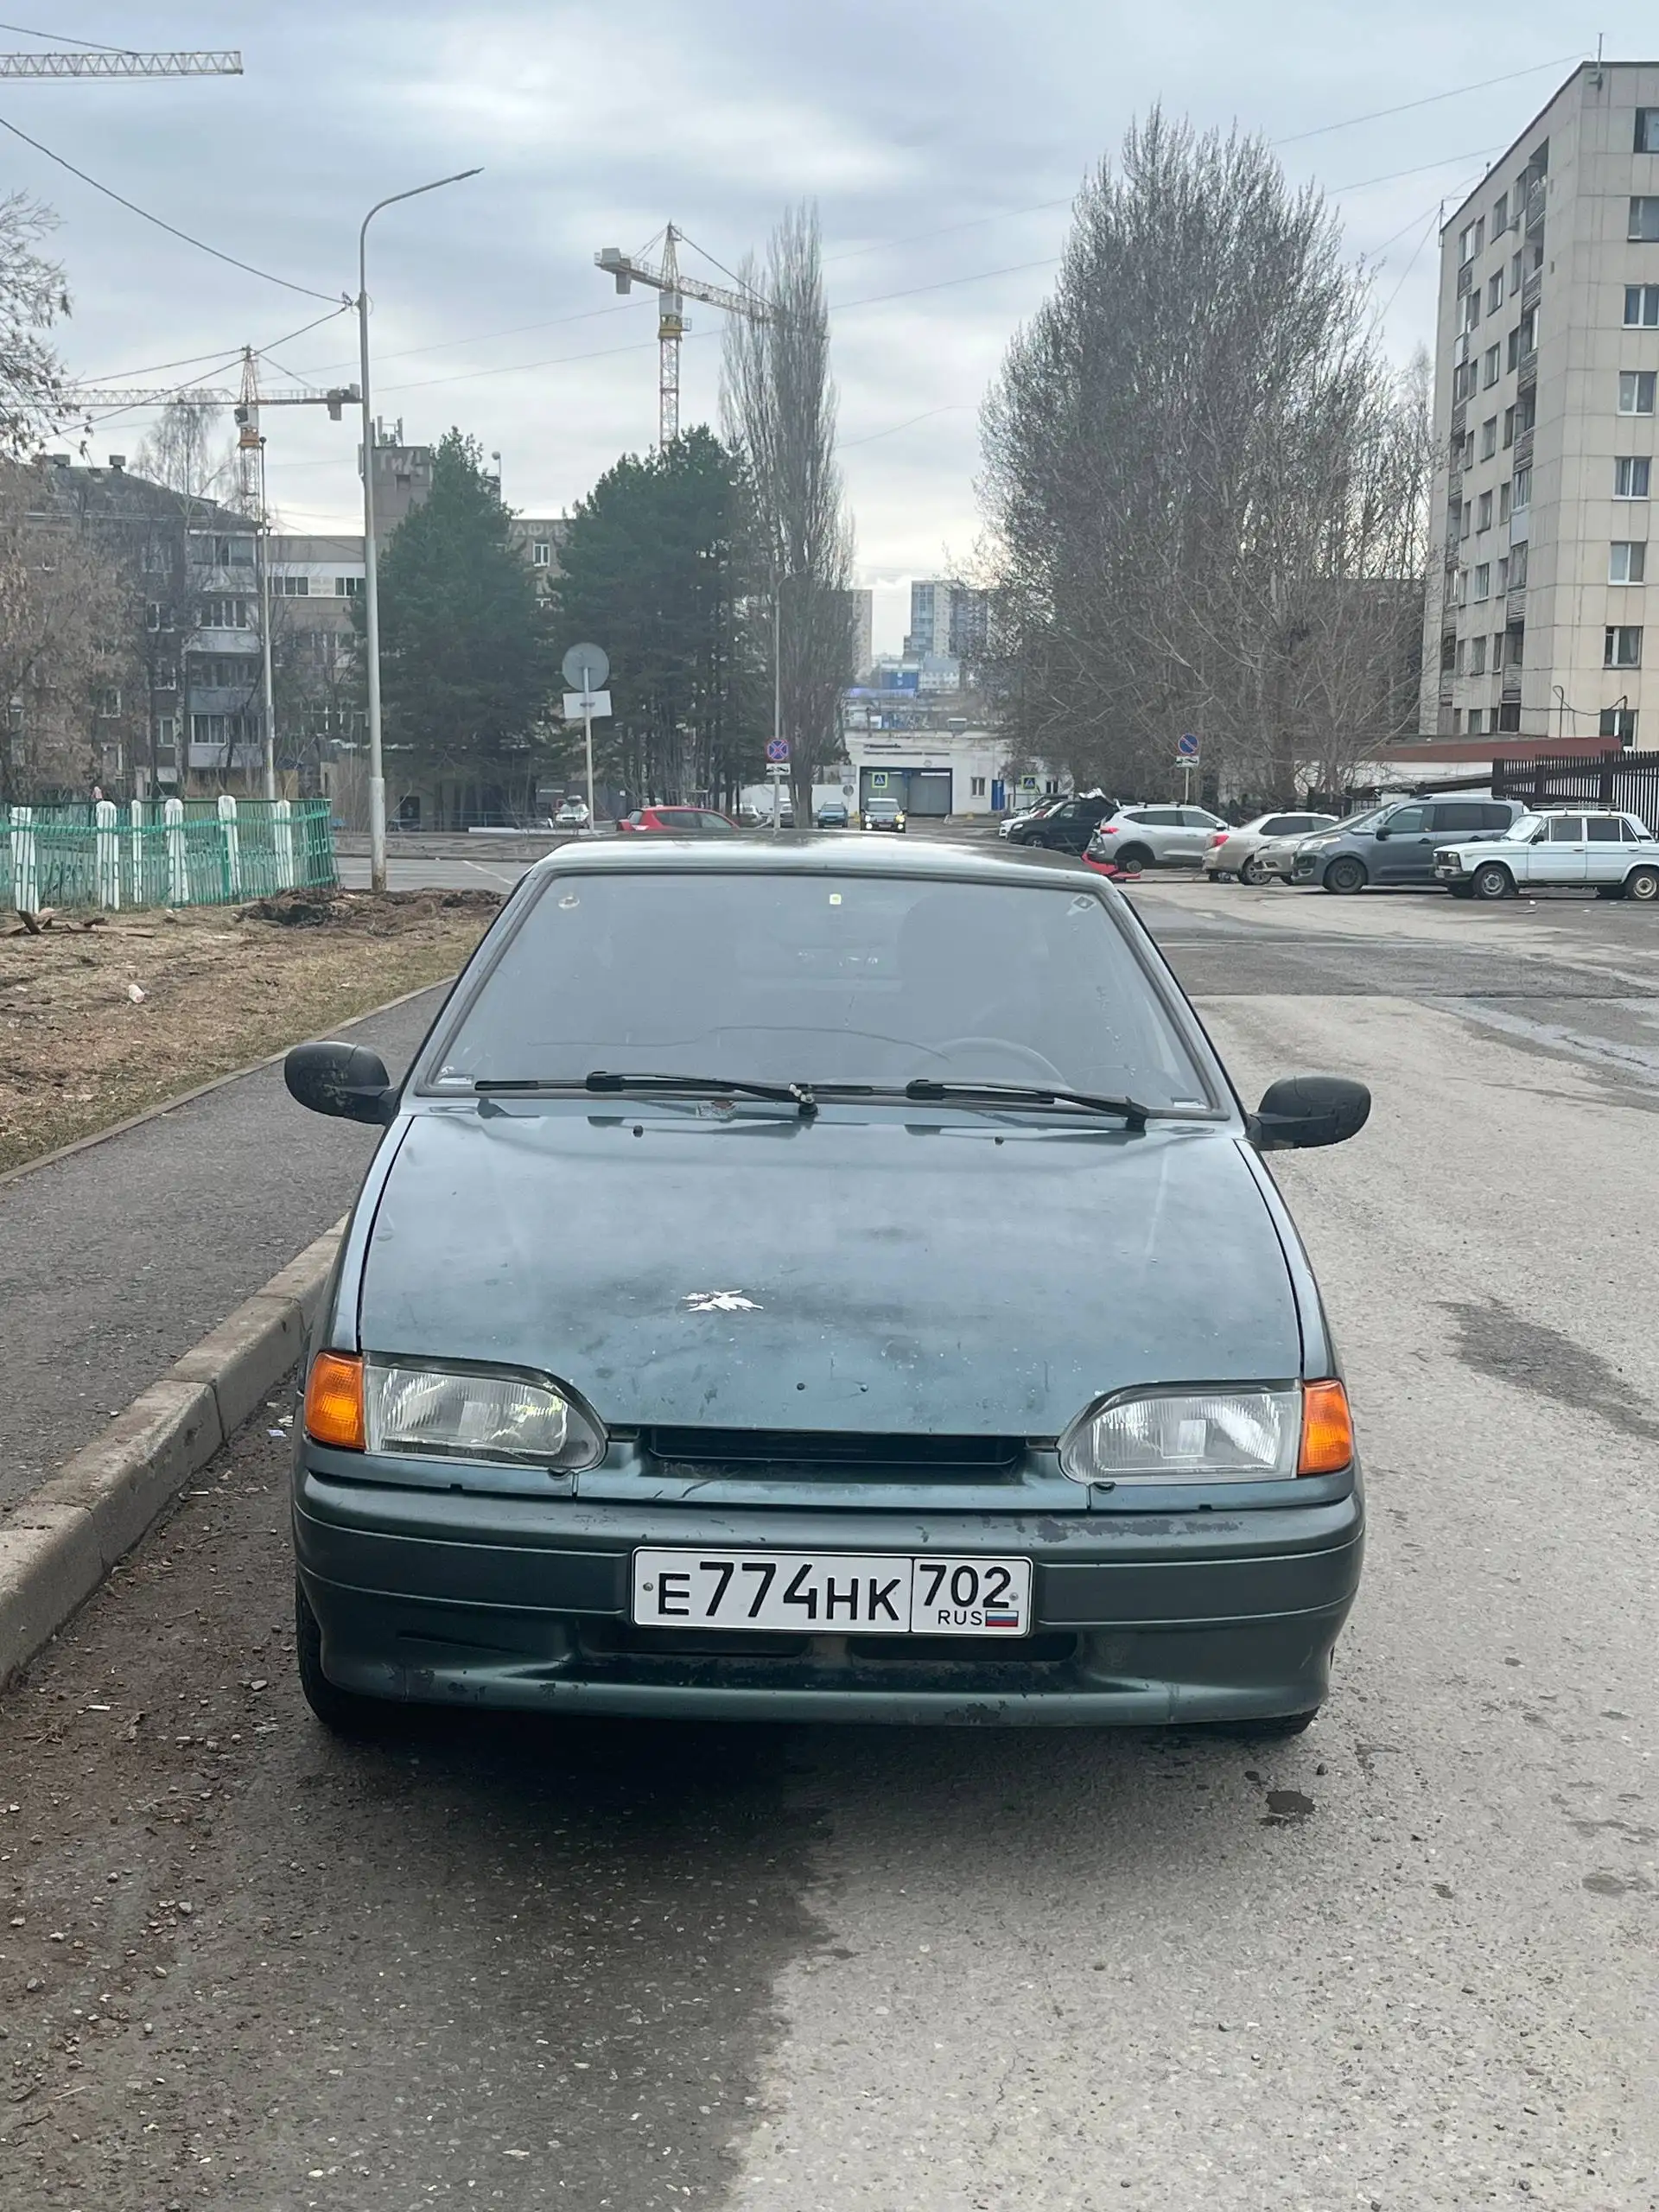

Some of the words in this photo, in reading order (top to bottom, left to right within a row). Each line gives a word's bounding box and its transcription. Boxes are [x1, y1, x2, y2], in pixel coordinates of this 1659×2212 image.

[658, 1560, 901, 1621] Е774НК
[919, 1563, 1012, 1609] 702
[938, 1609, 982, 1626] RUS
